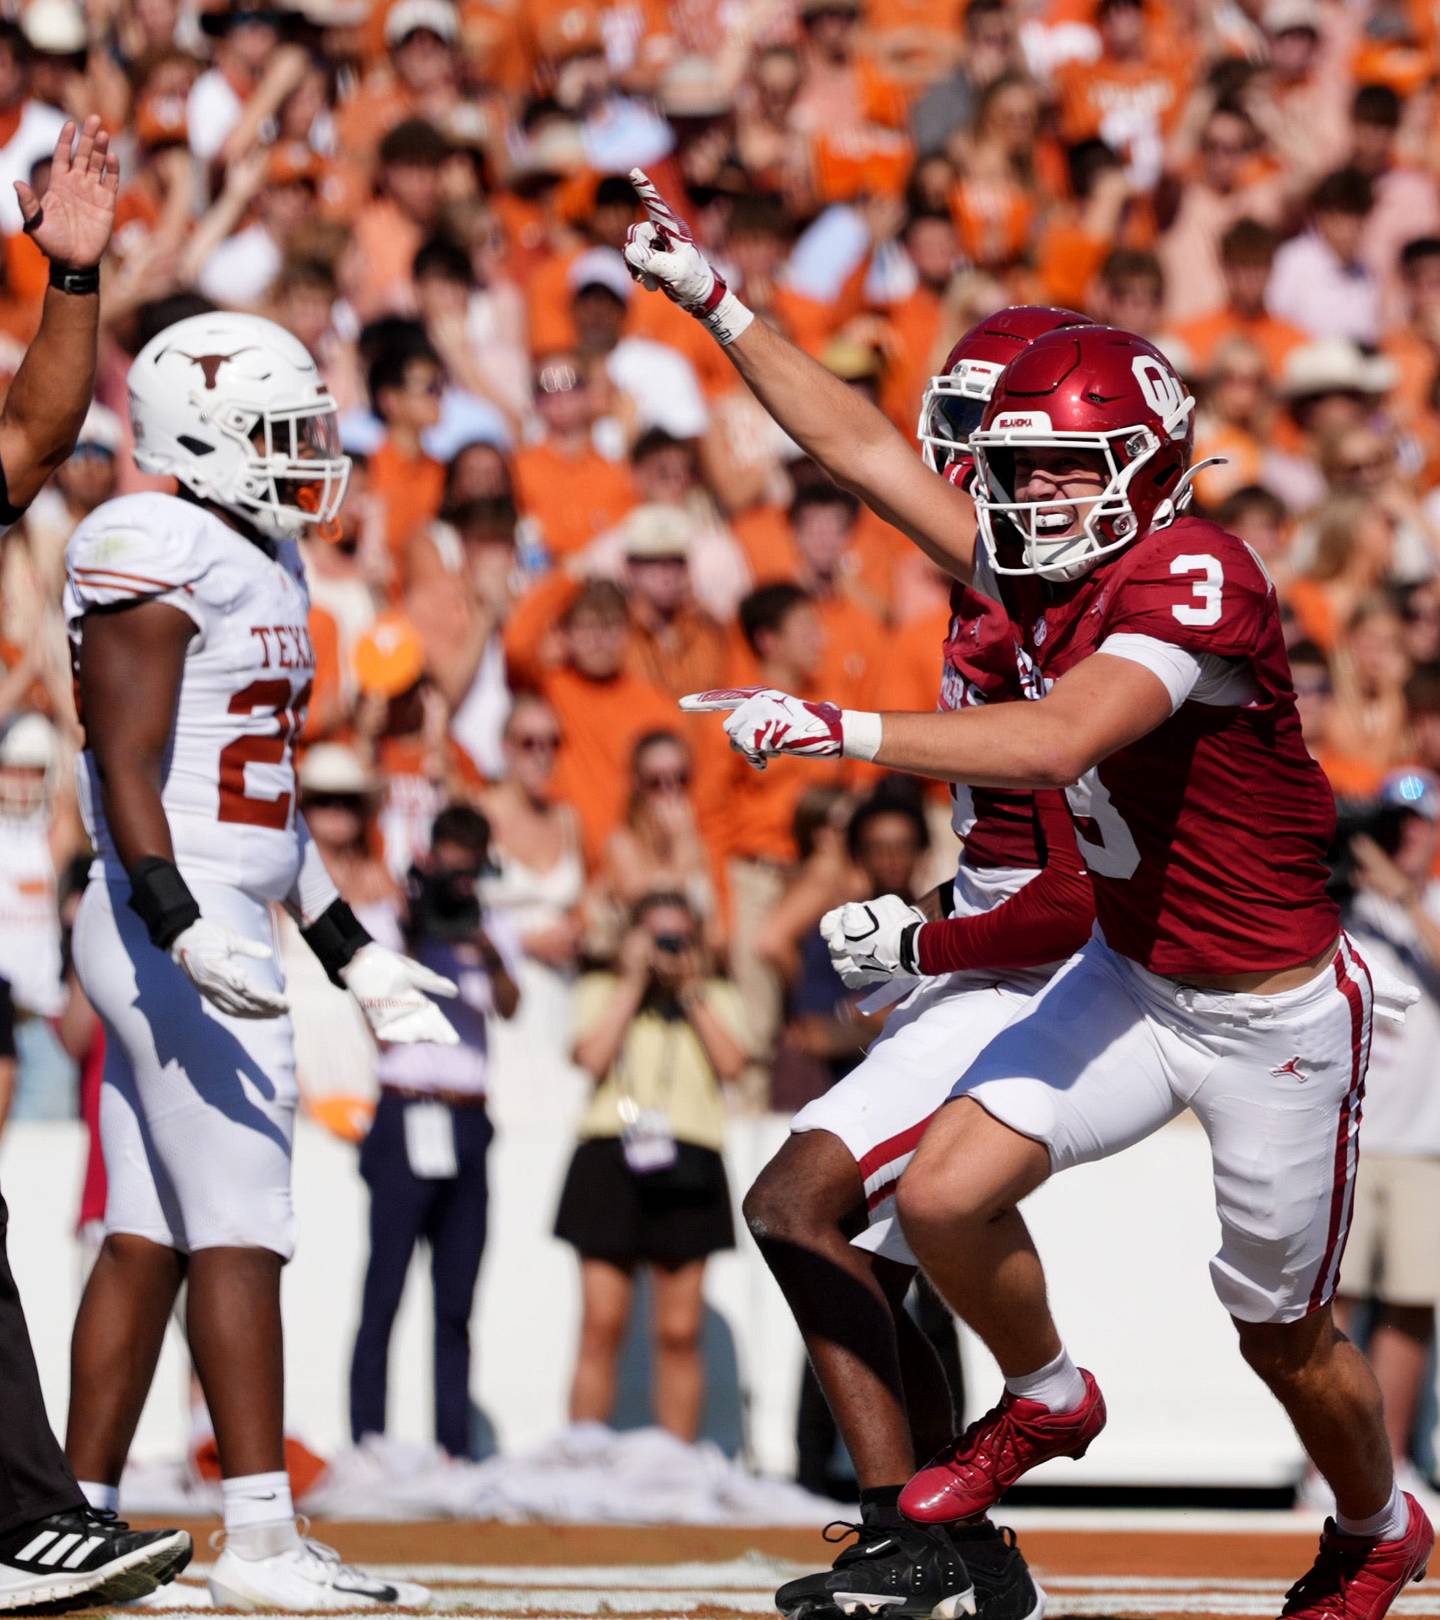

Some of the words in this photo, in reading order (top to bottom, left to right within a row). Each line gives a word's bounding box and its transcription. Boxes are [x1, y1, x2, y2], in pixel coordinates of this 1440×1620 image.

[1131, 355, 1189, 440] OU
[1169, 553, 1225, 627] 3
[217, 678, 314, 832] 2
